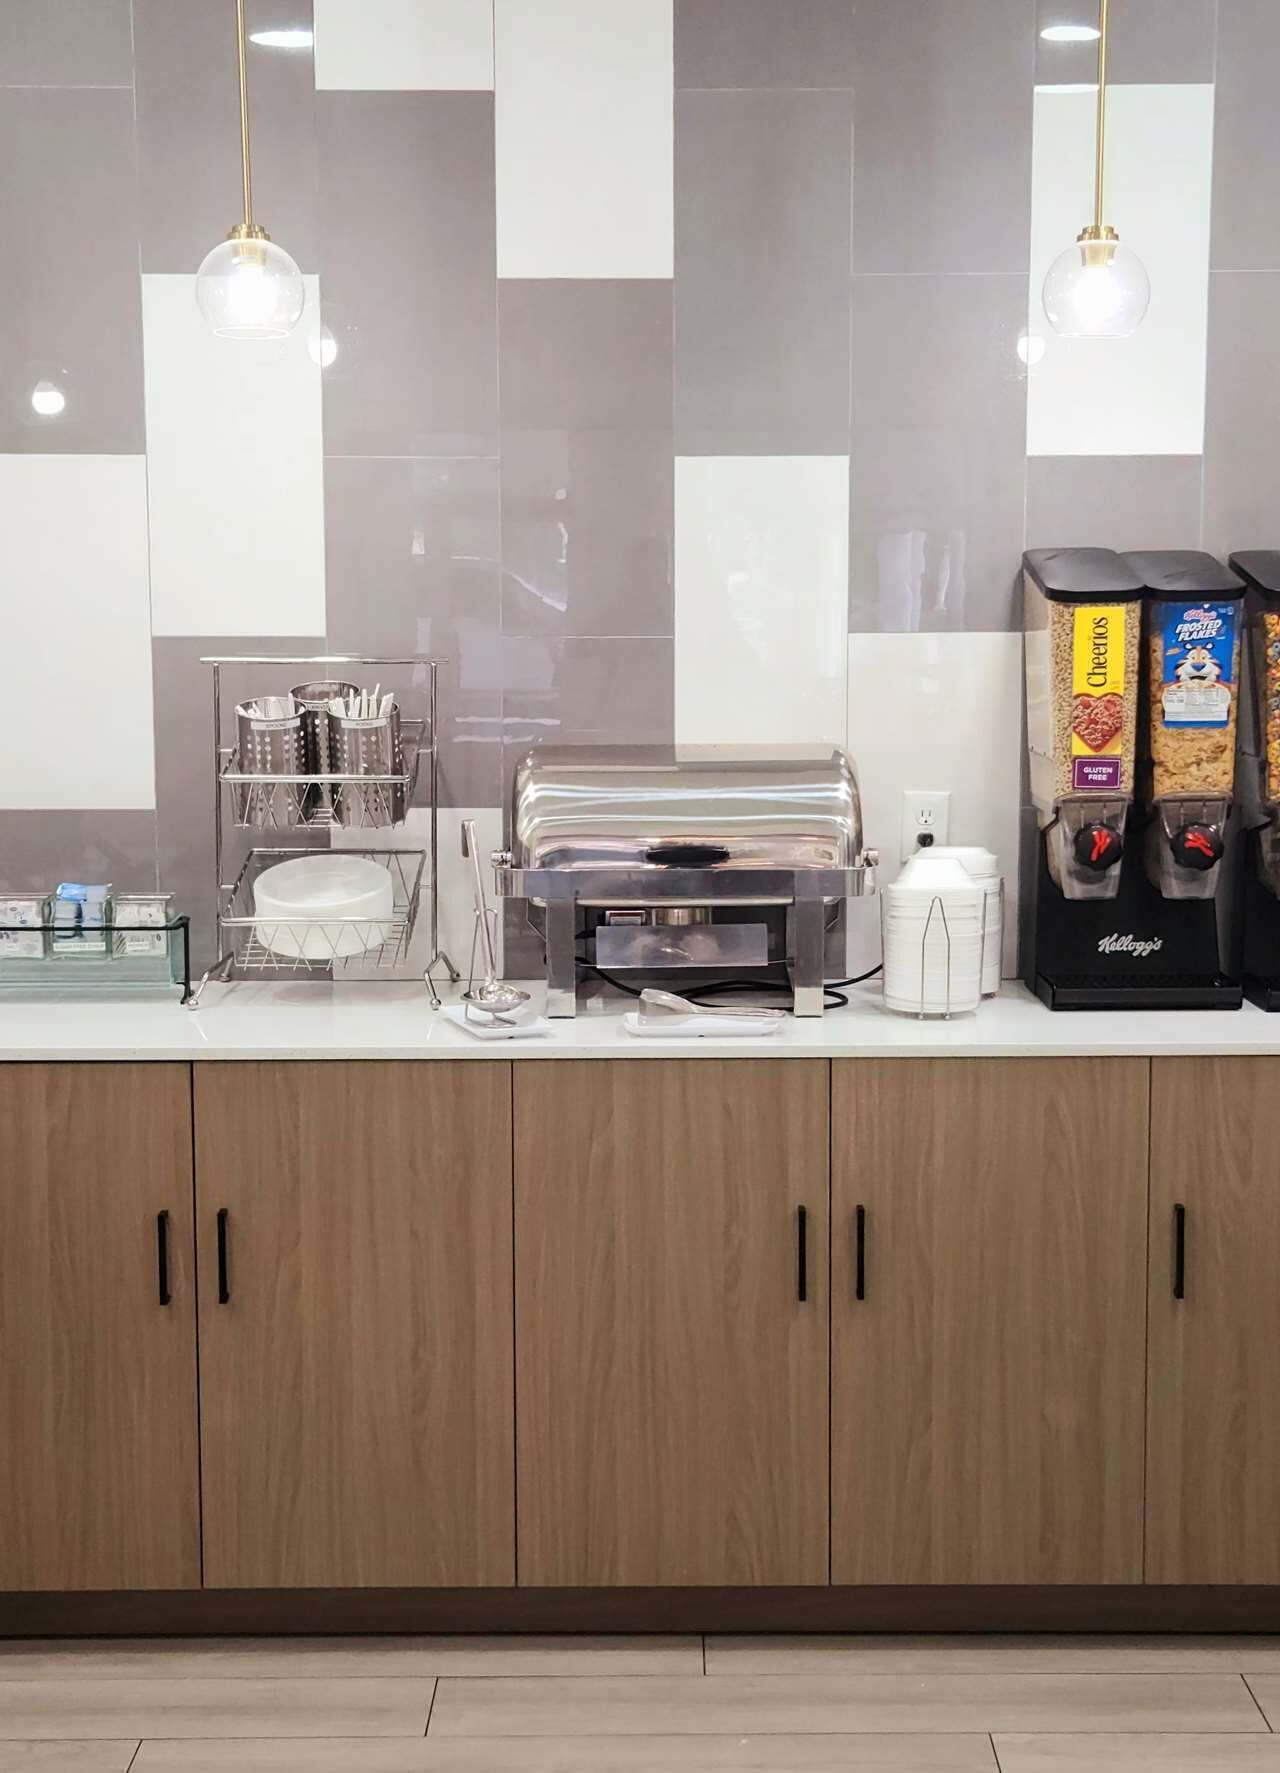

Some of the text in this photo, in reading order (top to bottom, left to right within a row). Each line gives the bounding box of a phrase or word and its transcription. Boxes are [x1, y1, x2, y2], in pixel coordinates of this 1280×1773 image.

[1175, 619, 1223, 634] FROSTED
[1178, 629, 1218, 642] FLAKES
[1087, 617, 1108, 687] Cheerios
[1083, 766, 1113, 774] GLUTEN
[1098, 933, 1163, 956] Kellogg's
